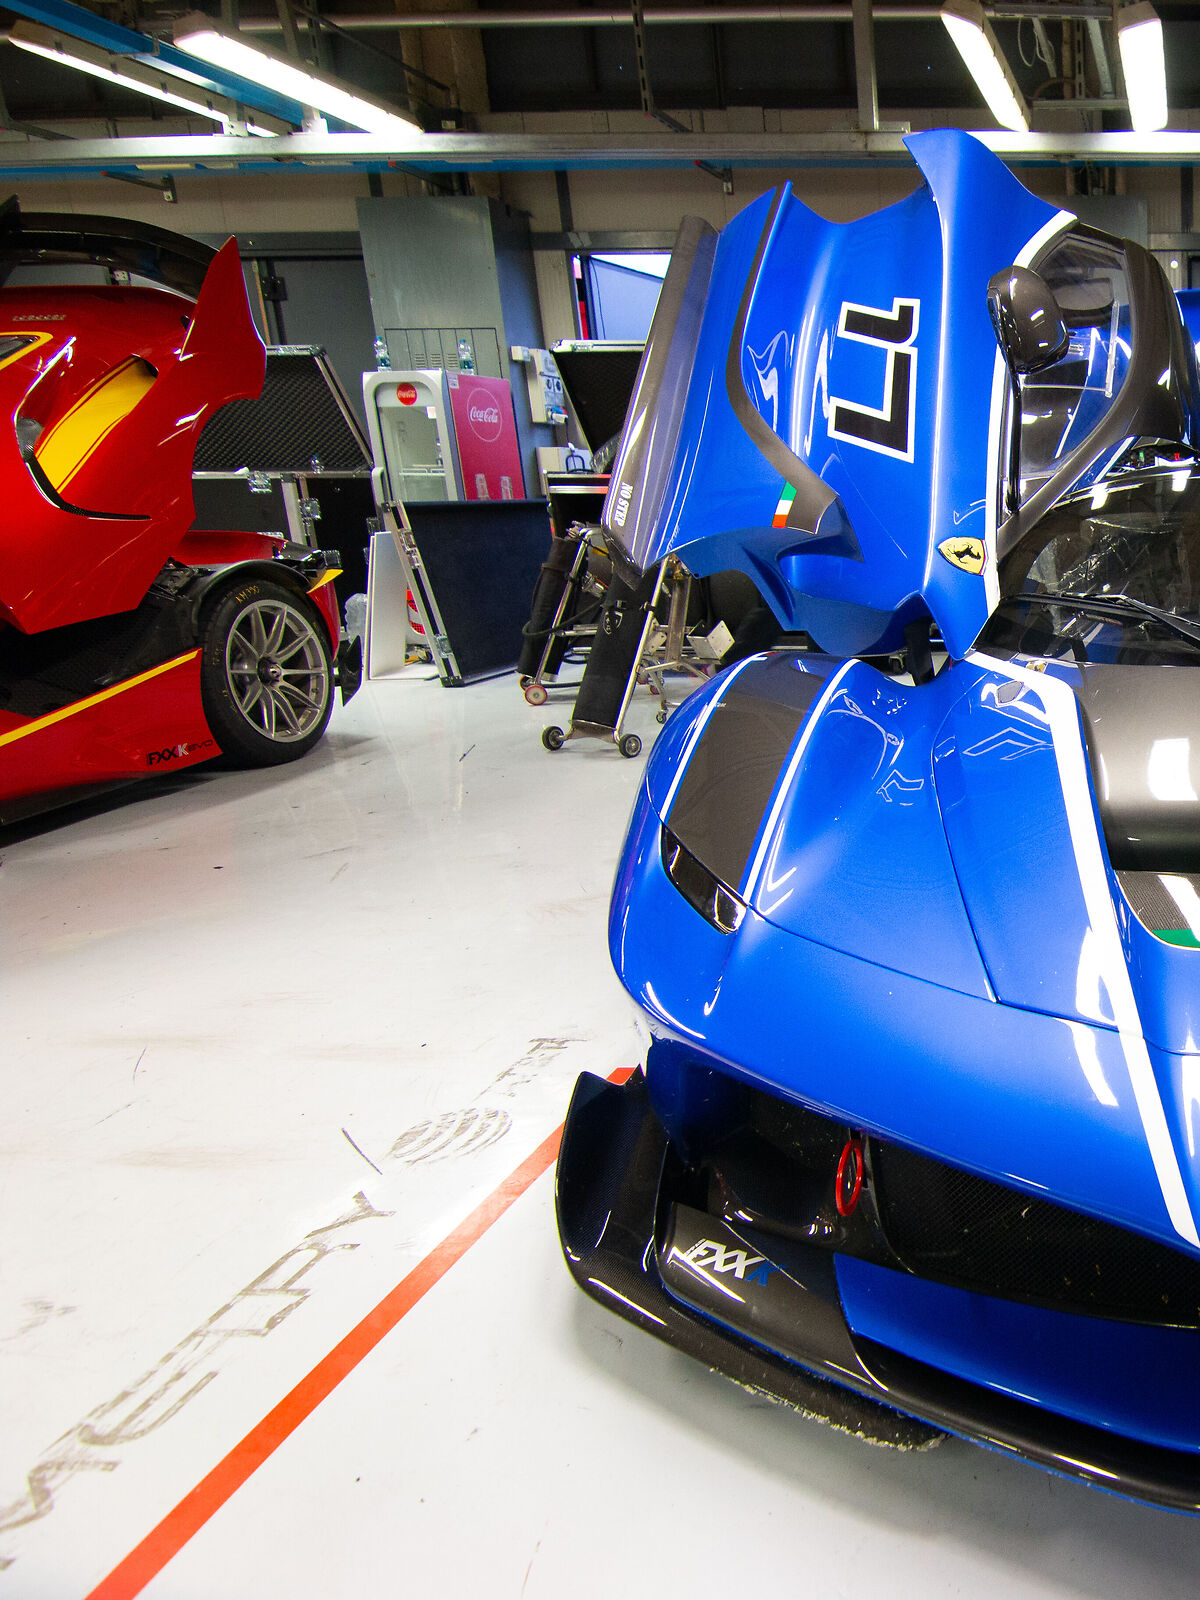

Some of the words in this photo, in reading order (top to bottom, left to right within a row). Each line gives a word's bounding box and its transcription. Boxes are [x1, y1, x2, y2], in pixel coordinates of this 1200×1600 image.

[827, 297, 921, 463] 17
[470, 406, 499, 424] Coca-Cola
[620, 482, 634, 500] NO
[614, 498, 630, 527] STEP
